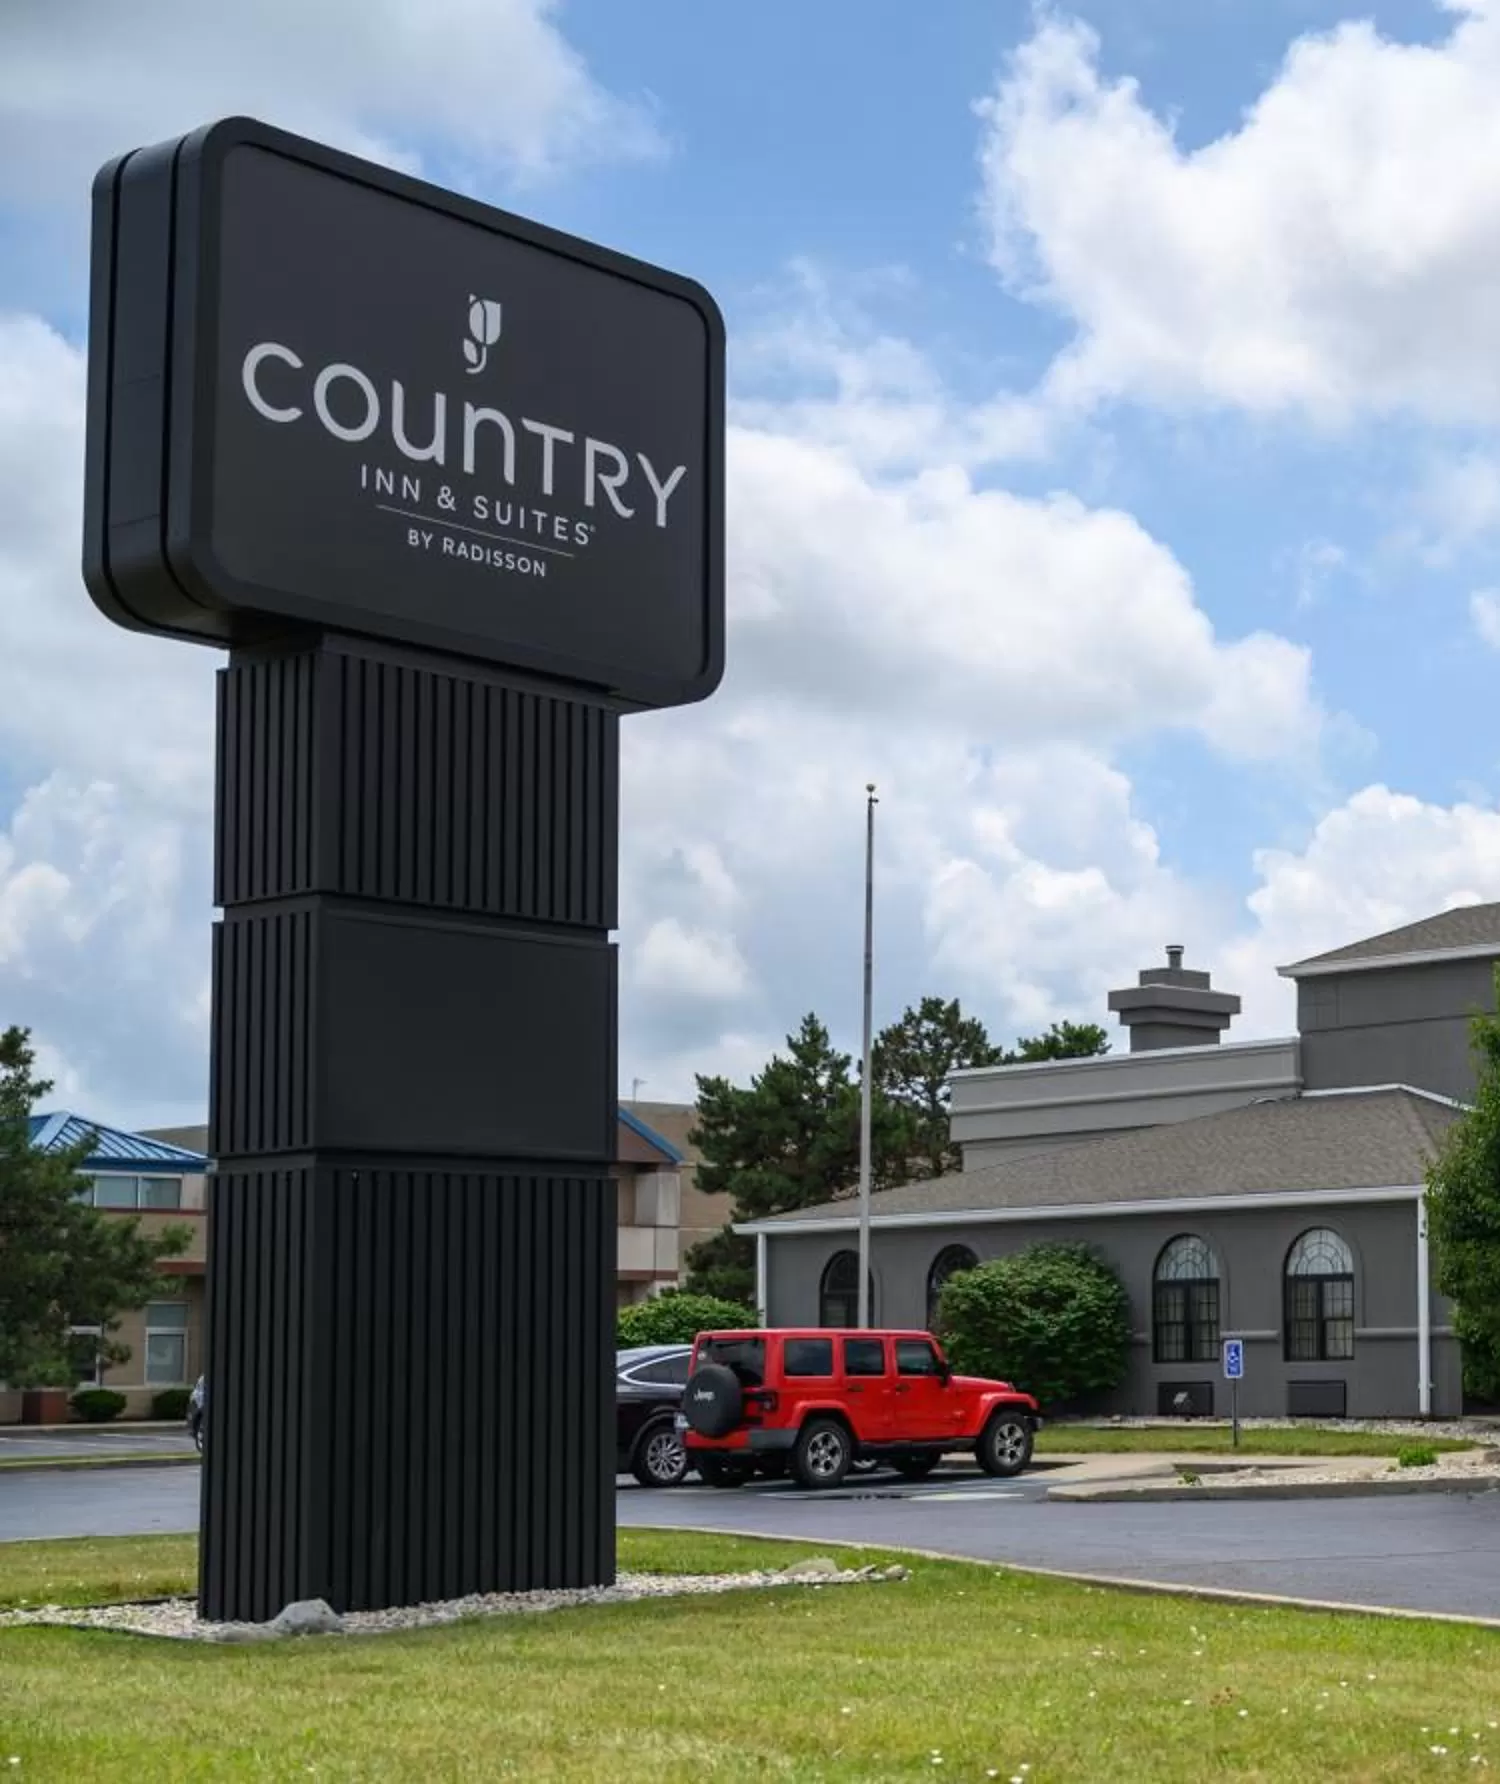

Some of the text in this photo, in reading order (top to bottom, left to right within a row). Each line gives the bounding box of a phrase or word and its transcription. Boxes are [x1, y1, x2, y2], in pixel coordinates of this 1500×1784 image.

[360, 462, 421, 502] INN
[436, 485, 457, 512] &
[407, 527, 547, 578] BY RADISSON
